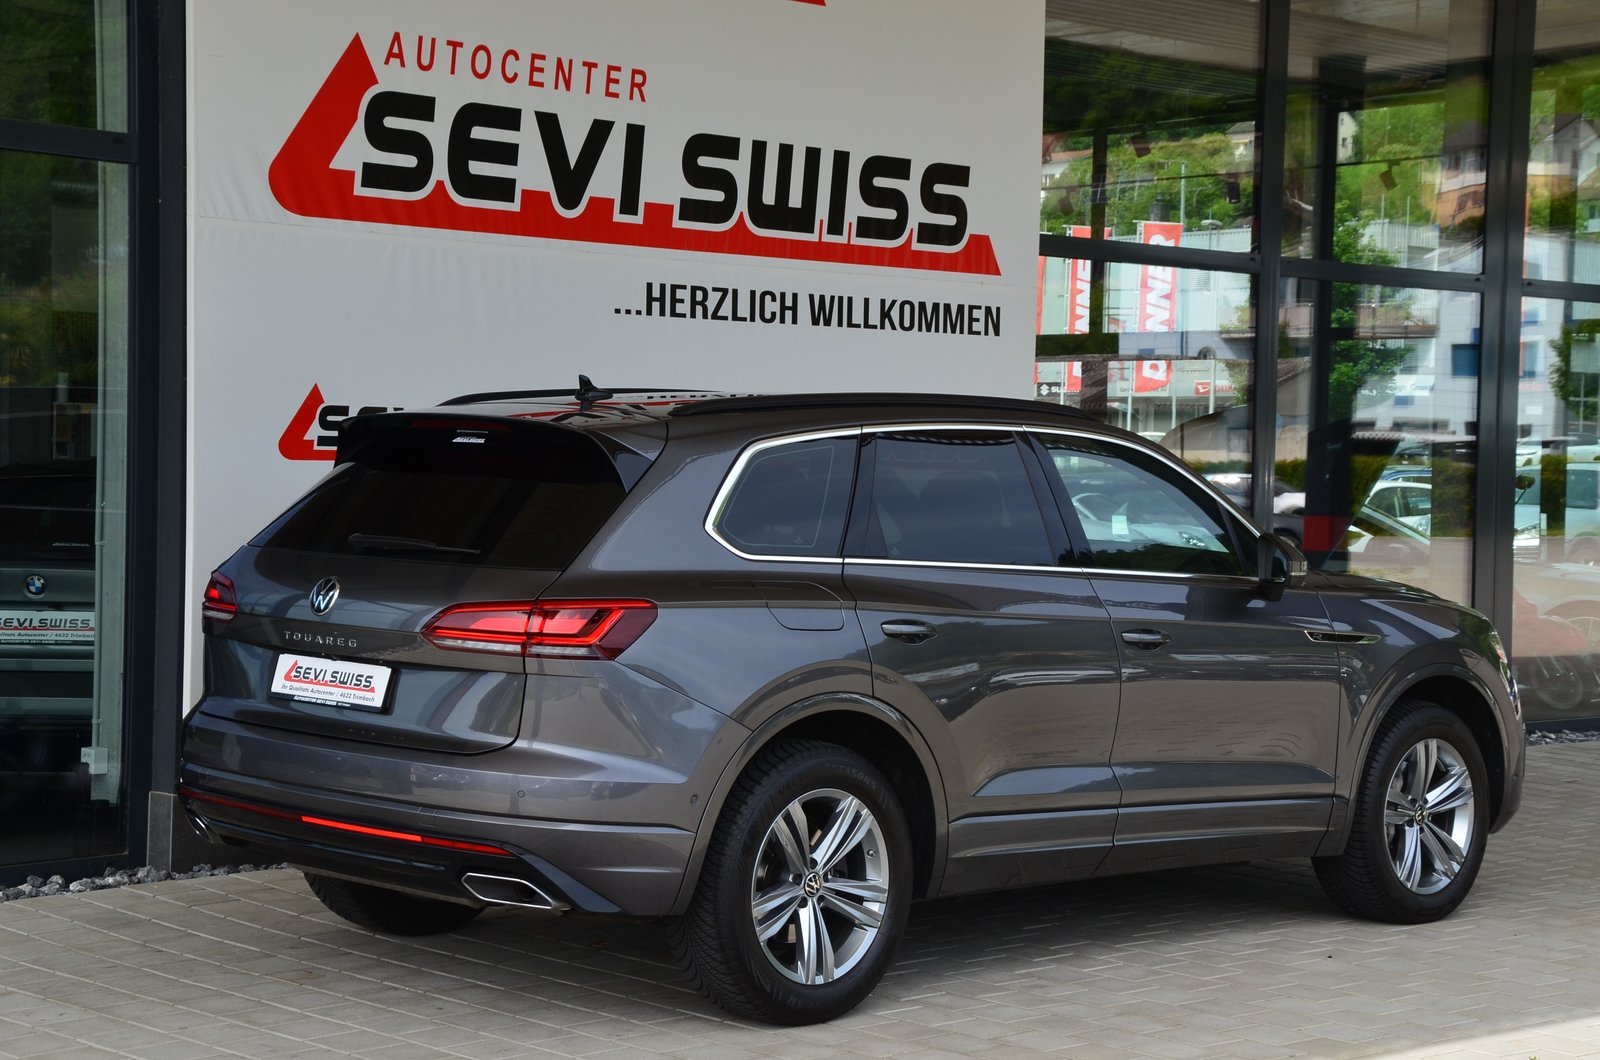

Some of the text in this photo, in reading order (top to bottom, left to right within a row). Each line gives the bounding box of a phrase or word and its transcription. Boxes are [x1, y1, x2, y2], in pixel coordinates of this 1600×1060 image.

[384, 31, 647, 103] AUTOCENTER
[360, 90, 971, 247] SEVI SWISS
[808, 293, 1001, 337] WILLKOMMEN
[37, 618, 91, 628] SWISS
[283, 630, 357, 648] TOUAREG
[293, 665, 374, 688] SEVI SWISS
[310, 687, 336, 697] Autocenter
[352, 693, 375, 702] Trimbach
